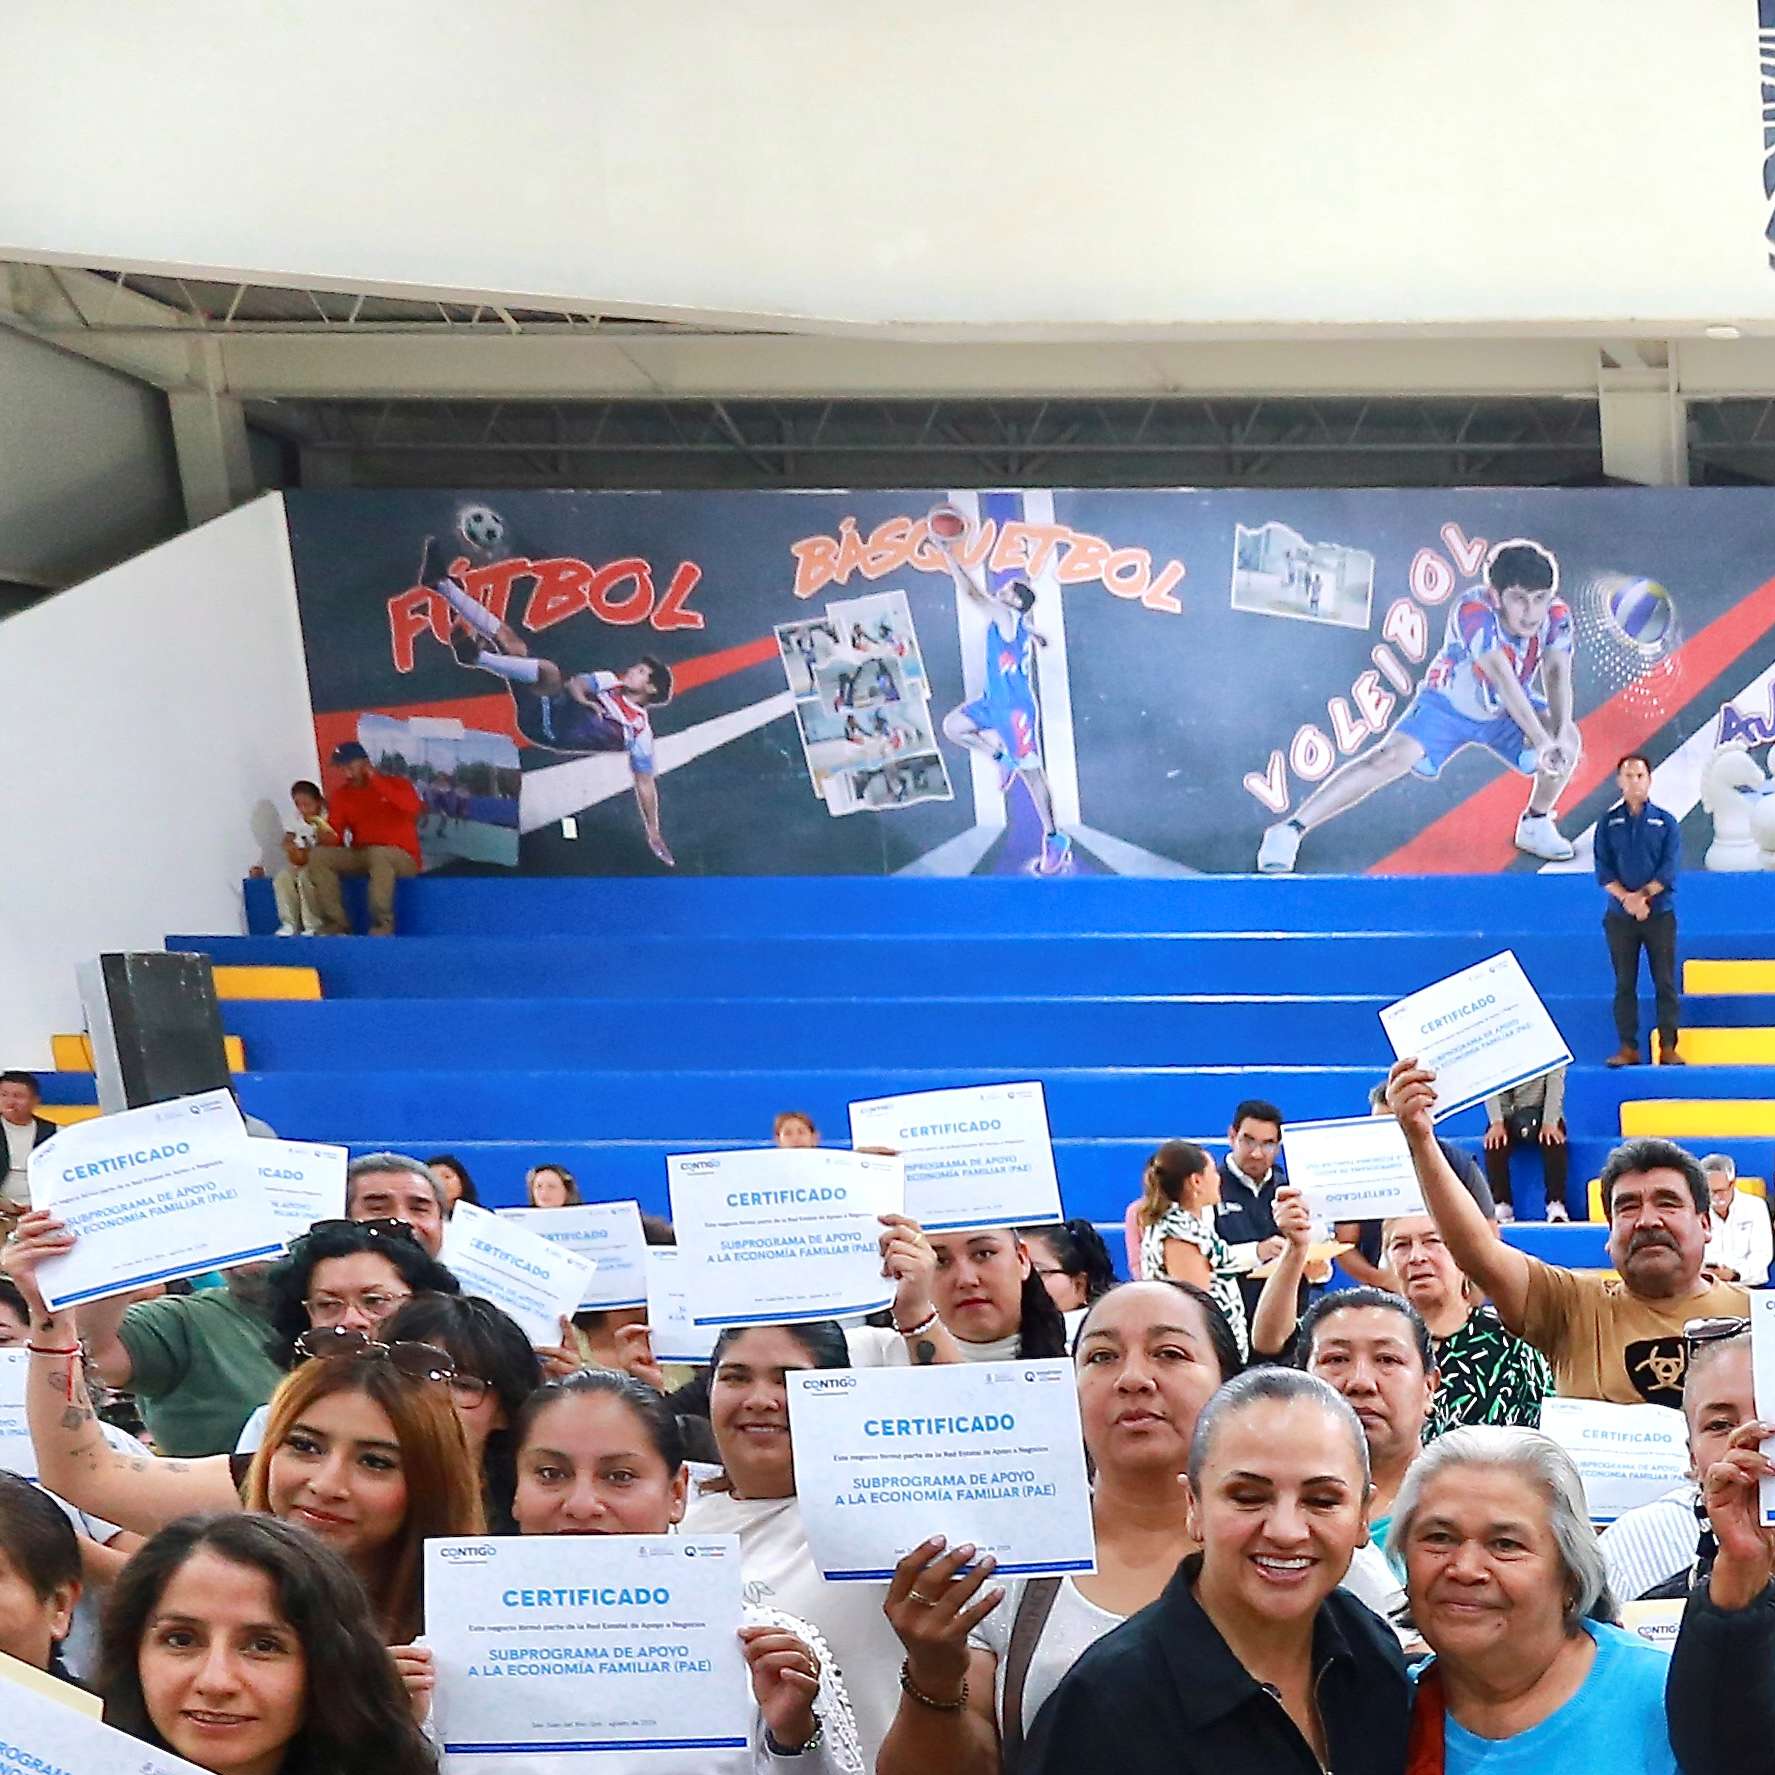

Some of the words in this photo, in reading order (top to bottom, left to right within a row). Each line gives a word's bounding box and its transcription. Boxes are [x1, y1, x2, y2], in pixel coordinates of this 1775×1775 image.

[1243, 521, 1491, 813] VOLEIBOL
[1419, 994, 1497, 1036] CERTIFICADO
[898, 1118, 1002, 1139] CERTIFICADO
[62, 1142, 191, 1184] CERTIFICADO
[726, 1186, 848, 1208] CERTIFICADO
[803, 1376, 856, 1391] CONTIGO
[864, 1414, 1015, 1436] CERTIFICADO
[1582, 1429, 1672, 1443] CERTIFICADO
[853, 1474, 965, 1489] SUBPROGRAMA
[970, 1473, 988, 1484] DE
[991, 1471, 1035, 1483] APOYO
[834, 1496, 845, 1505] A
[848, 1494, 866, 1504] LA
[871, 1489, 951, 1503] ECONOMÍA
[956, 1487, 1020, 1501] FAMILIAR
[1023, 1483, 1056, 1498] (PAE)
[440, 1544, 497, 1559] CONTIGO
[502, 1587, 670, 1607] CERTIFICADO
[1637, 1625, 1678, 1636] CONTIG
[488, 1647, 609, 1662] SUBPROGRAMA
[615, 1647, 633, 1659] DE
[638, 1645, 689, 1658] APOYO
[468, 1665, 478, 1677] A
[483, 1664, 502, 1677] LA
[507, 1661, 594, 1676] ECONOMÍA
[599, 1660, 670, 1674] FAMILIAR
[674, 1659, 712, 1673] (PAE)
